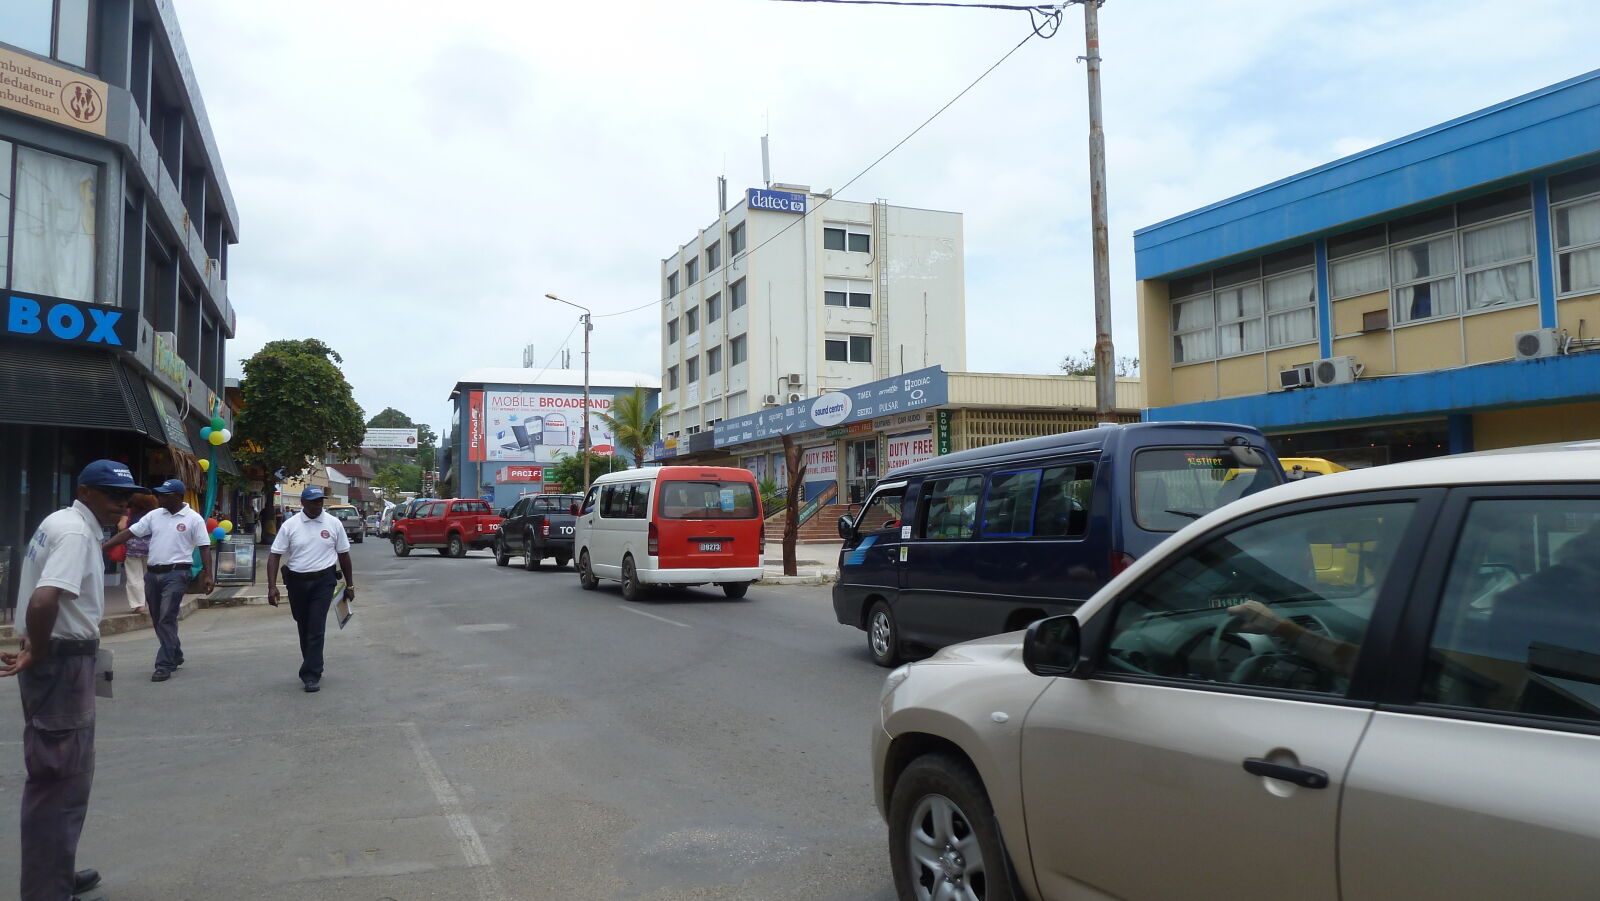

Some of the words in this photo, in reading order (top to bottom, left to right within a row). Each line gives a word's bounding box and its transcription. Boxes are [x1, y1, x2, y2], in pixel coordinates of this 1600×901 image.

[751, 190, 789, 210] datec
[8, 295, 123, 346] BOX
[911, 376, 931, 389] ZODIAC
[857, 390, 872, 400] TIMEX
[491, 396, 536, 407] MOBILE
[539, 397, 611, 409] BROADBAND
[879, 400, 899, 413] PULSAR
[815, 405, 829, 417] sound
[829, 403, 844, 414] centre
[857, 406, 873, 417] SEIKO
[940, 411, 948, 438] DOWN
[889, 442, 909, 457] DUTY
[913, 439, 933, 455] FREE
